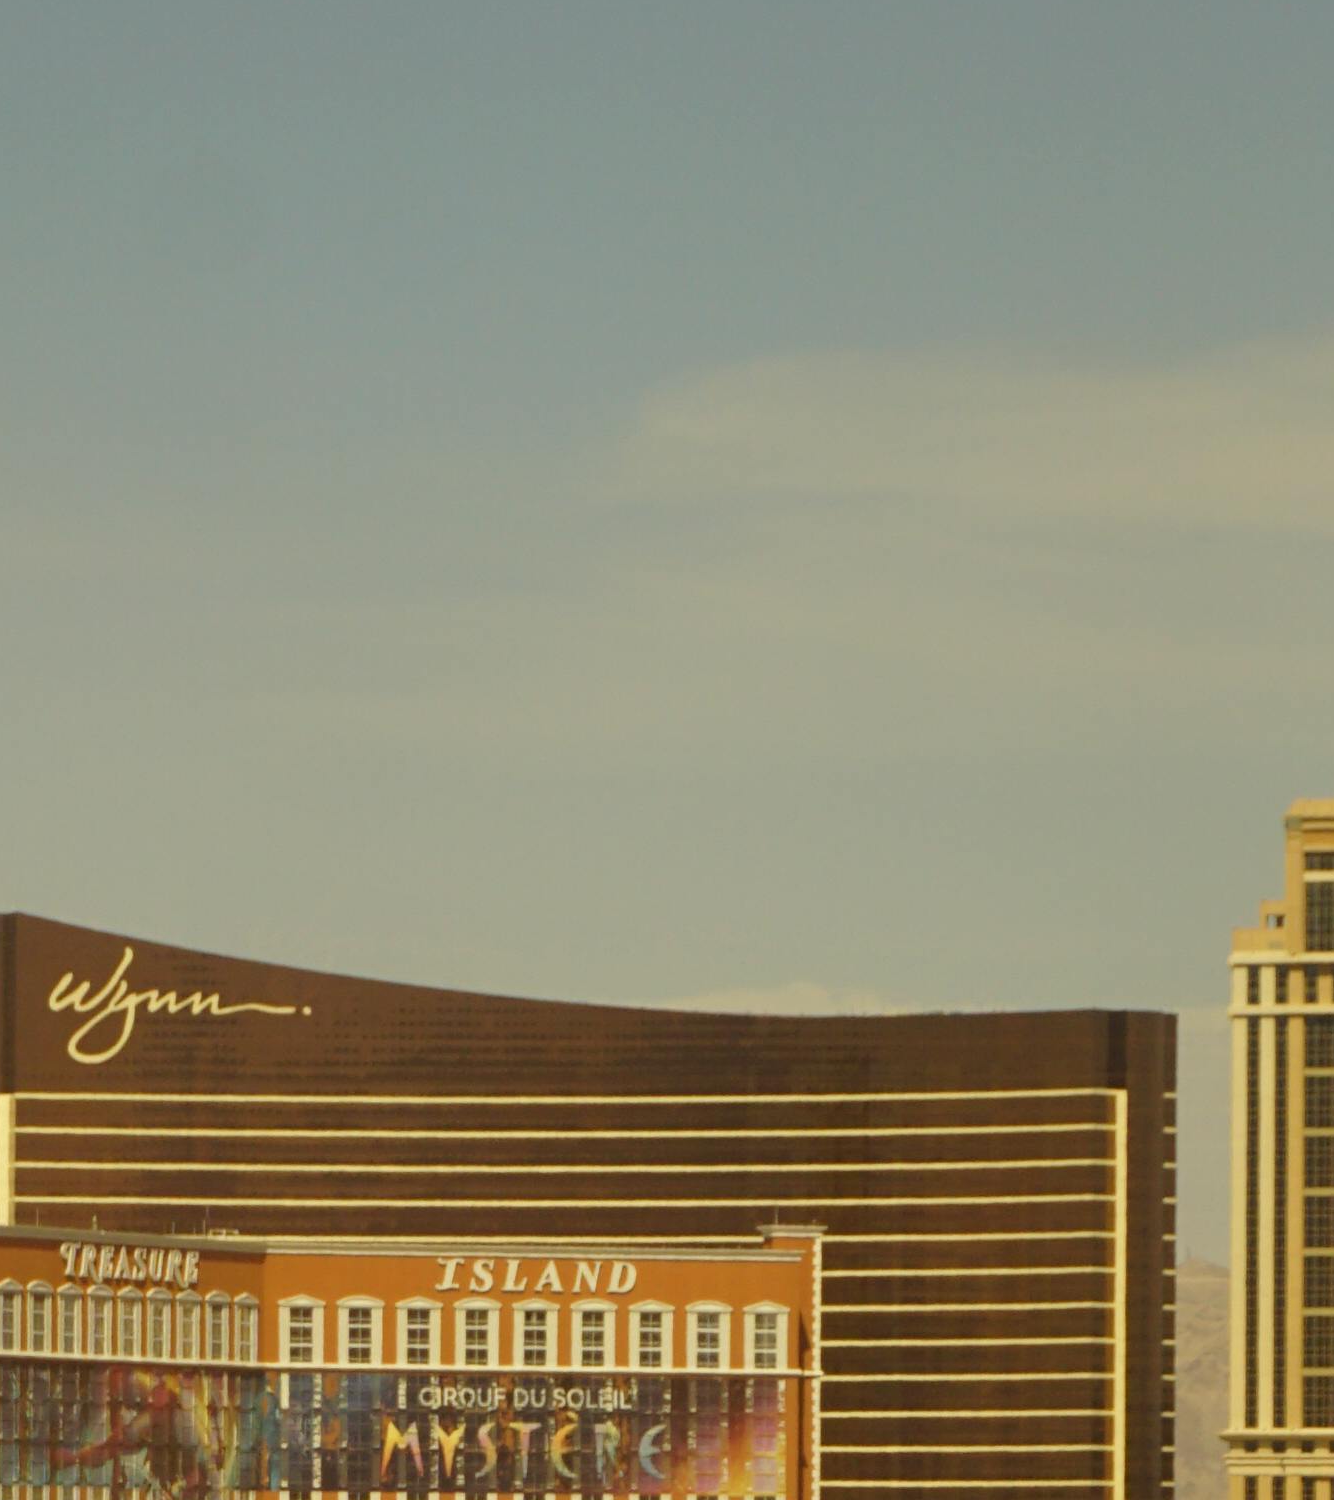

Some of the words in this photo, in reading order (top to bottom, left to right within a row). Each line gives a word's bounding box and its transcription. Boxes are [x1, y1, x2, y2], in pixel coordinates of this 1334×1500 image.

[60, 1242, 200, 1288] TREASURE
[434, 1257, 638, 1294] ISLAND
[419, 1386, 506, 1411] CIRQUE
[513, 1387, 546, 1409] DU
[552, 1386, 633, 1411] SOLEIL
